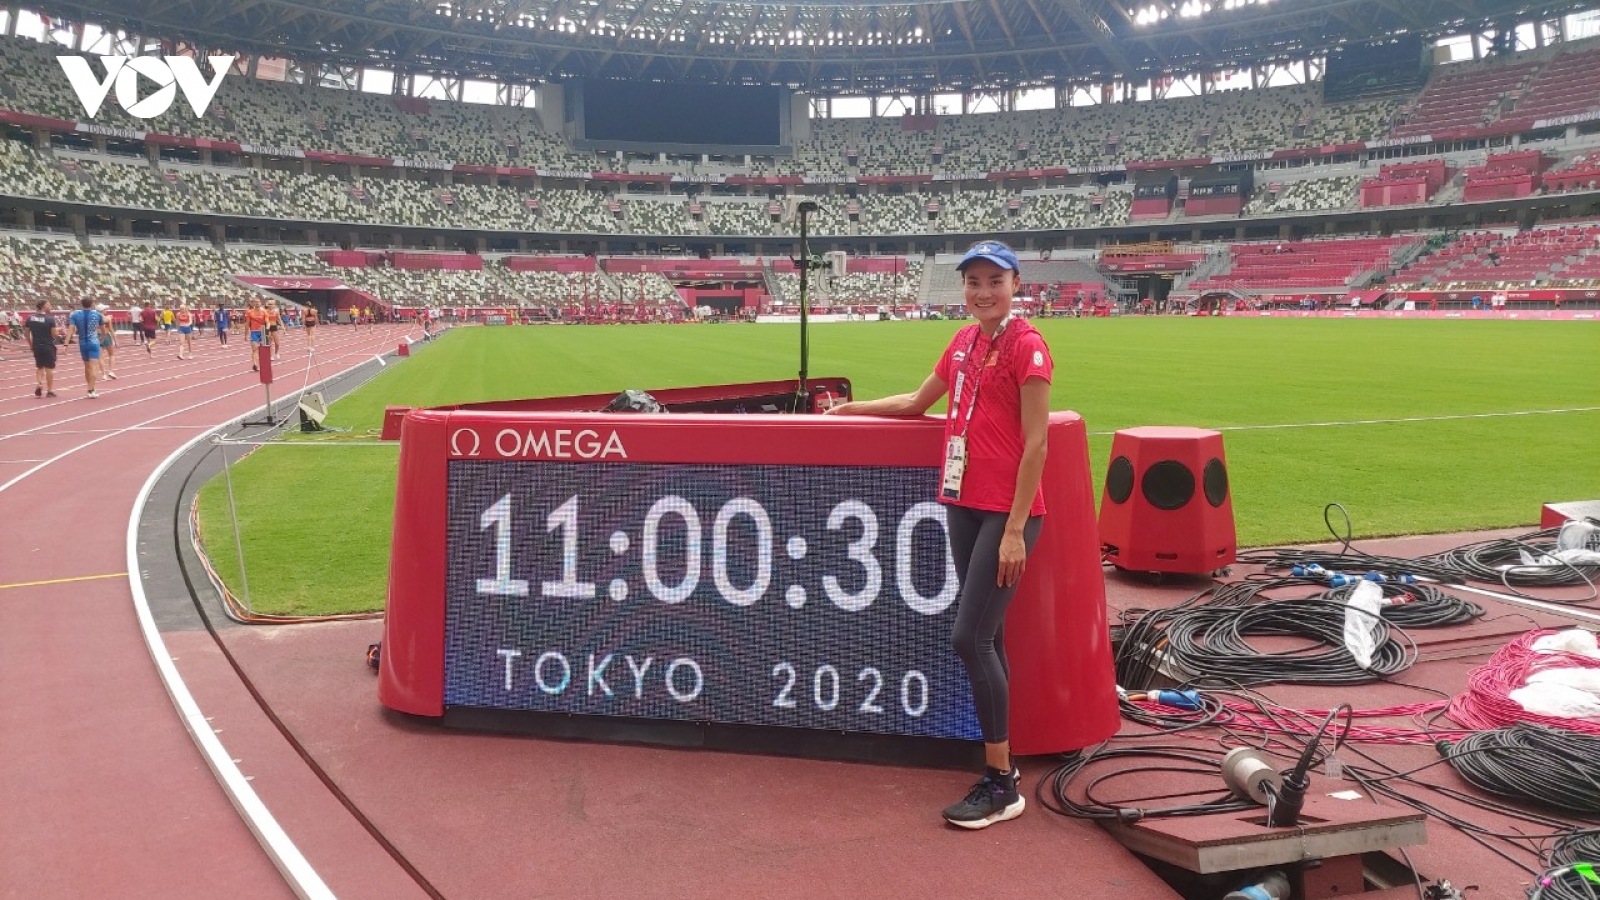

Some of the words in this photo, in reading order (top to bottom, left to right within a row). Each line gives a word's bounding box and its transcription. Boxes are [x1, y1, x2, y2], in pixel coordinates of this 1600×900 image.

[495, 429, 627, 458] OMEGA
[475, 492, 960, 616] 11:00:30
[497, 648, 703, 701] TOKYO
[771, 661, 929, 717] 2020
